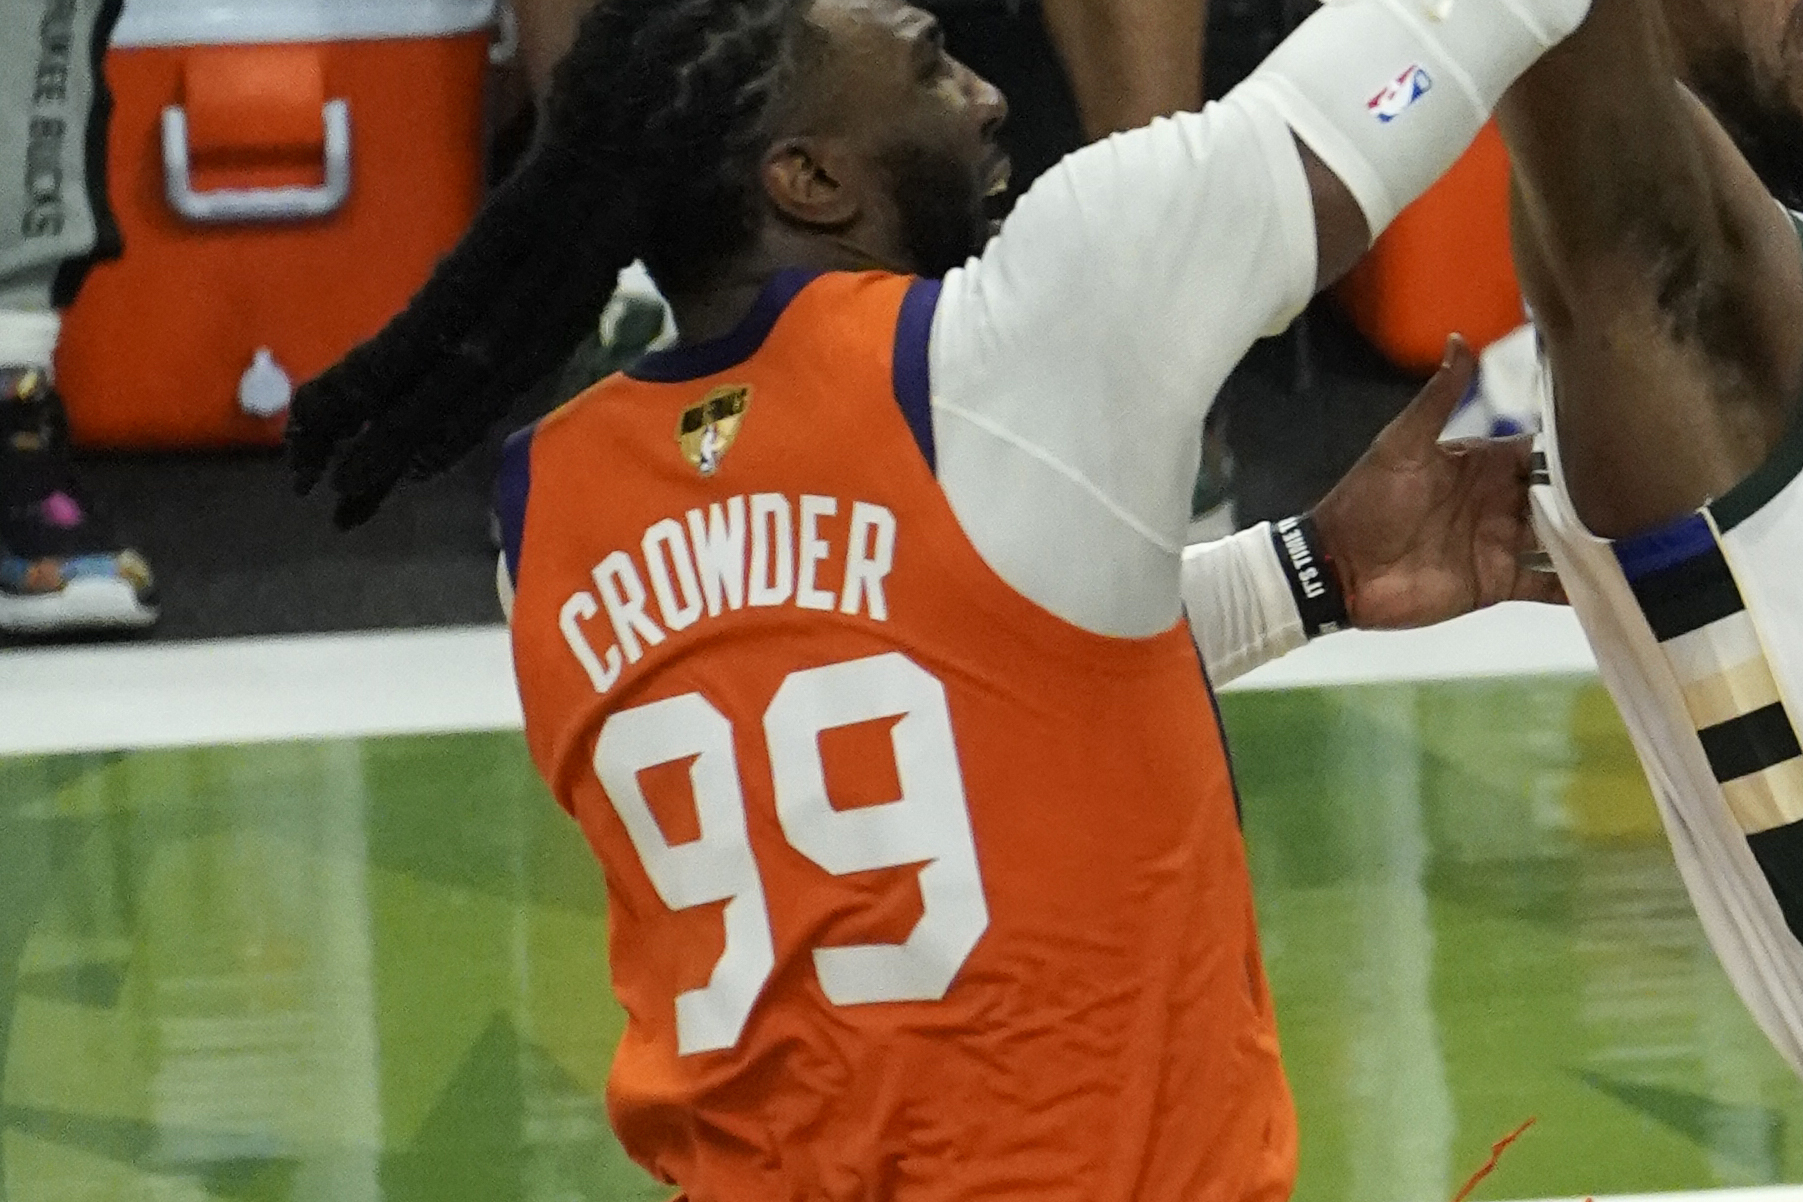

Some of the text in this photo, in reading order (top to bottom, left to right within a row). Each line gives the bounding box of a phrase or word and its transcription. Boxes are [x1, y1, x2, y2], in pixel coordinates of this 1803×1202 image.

[558, 492, 897, 694] CROWDER
[1281, 528, 1313, 570] TIME
[593, 652, 991, 1058] 99
